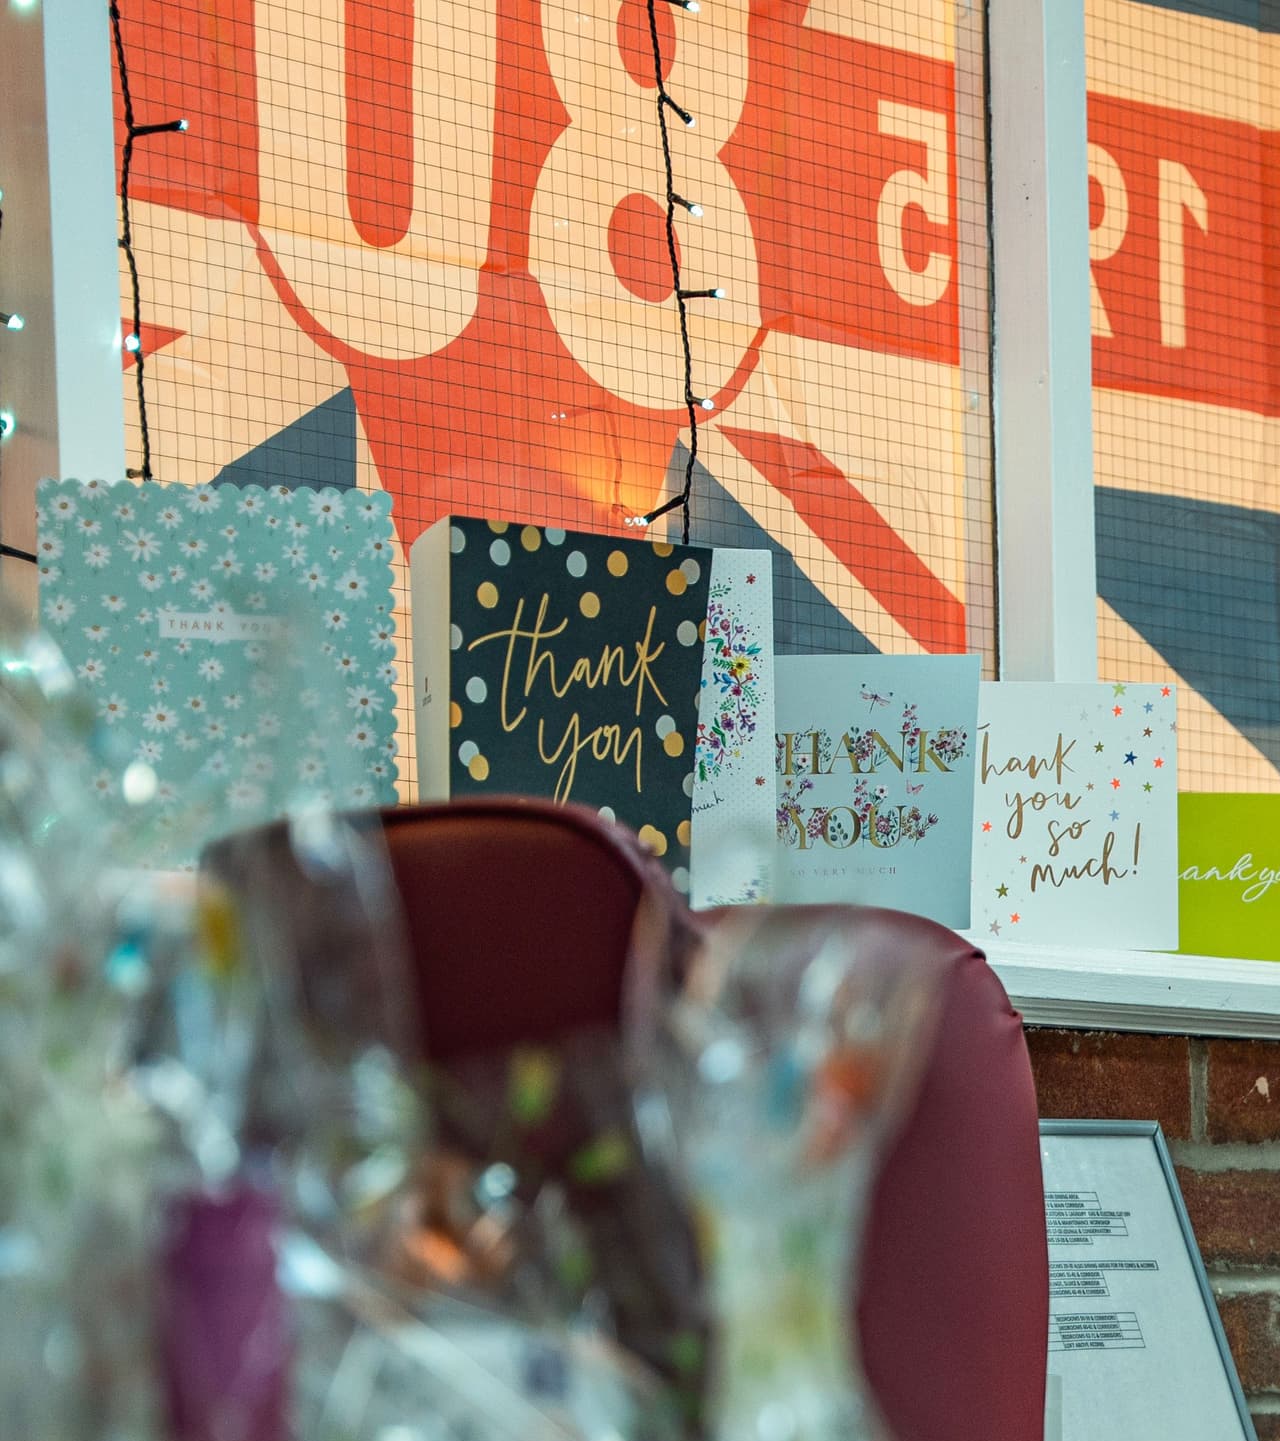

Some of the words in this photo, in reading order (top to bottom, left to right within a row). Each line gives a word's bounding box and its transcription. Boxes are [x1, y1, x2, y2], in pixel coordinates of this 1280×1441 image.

[168, 619, 225, 632] THANK
[240, 622, 272, 633] YOU
[468, 592, 669, 732] thank
[538, 712, 643, 807] you
[780, 730, 956, 776] HANK
[788, 804, 908, 850] YOU
[1005, 792, 1082, 840] you
[1048, 819, 1091, 857] so
[856, 865, 897, 876] MUCH
[1031, 822, 1141, 892] much!
[1178, 853, 1259, 882] ank
